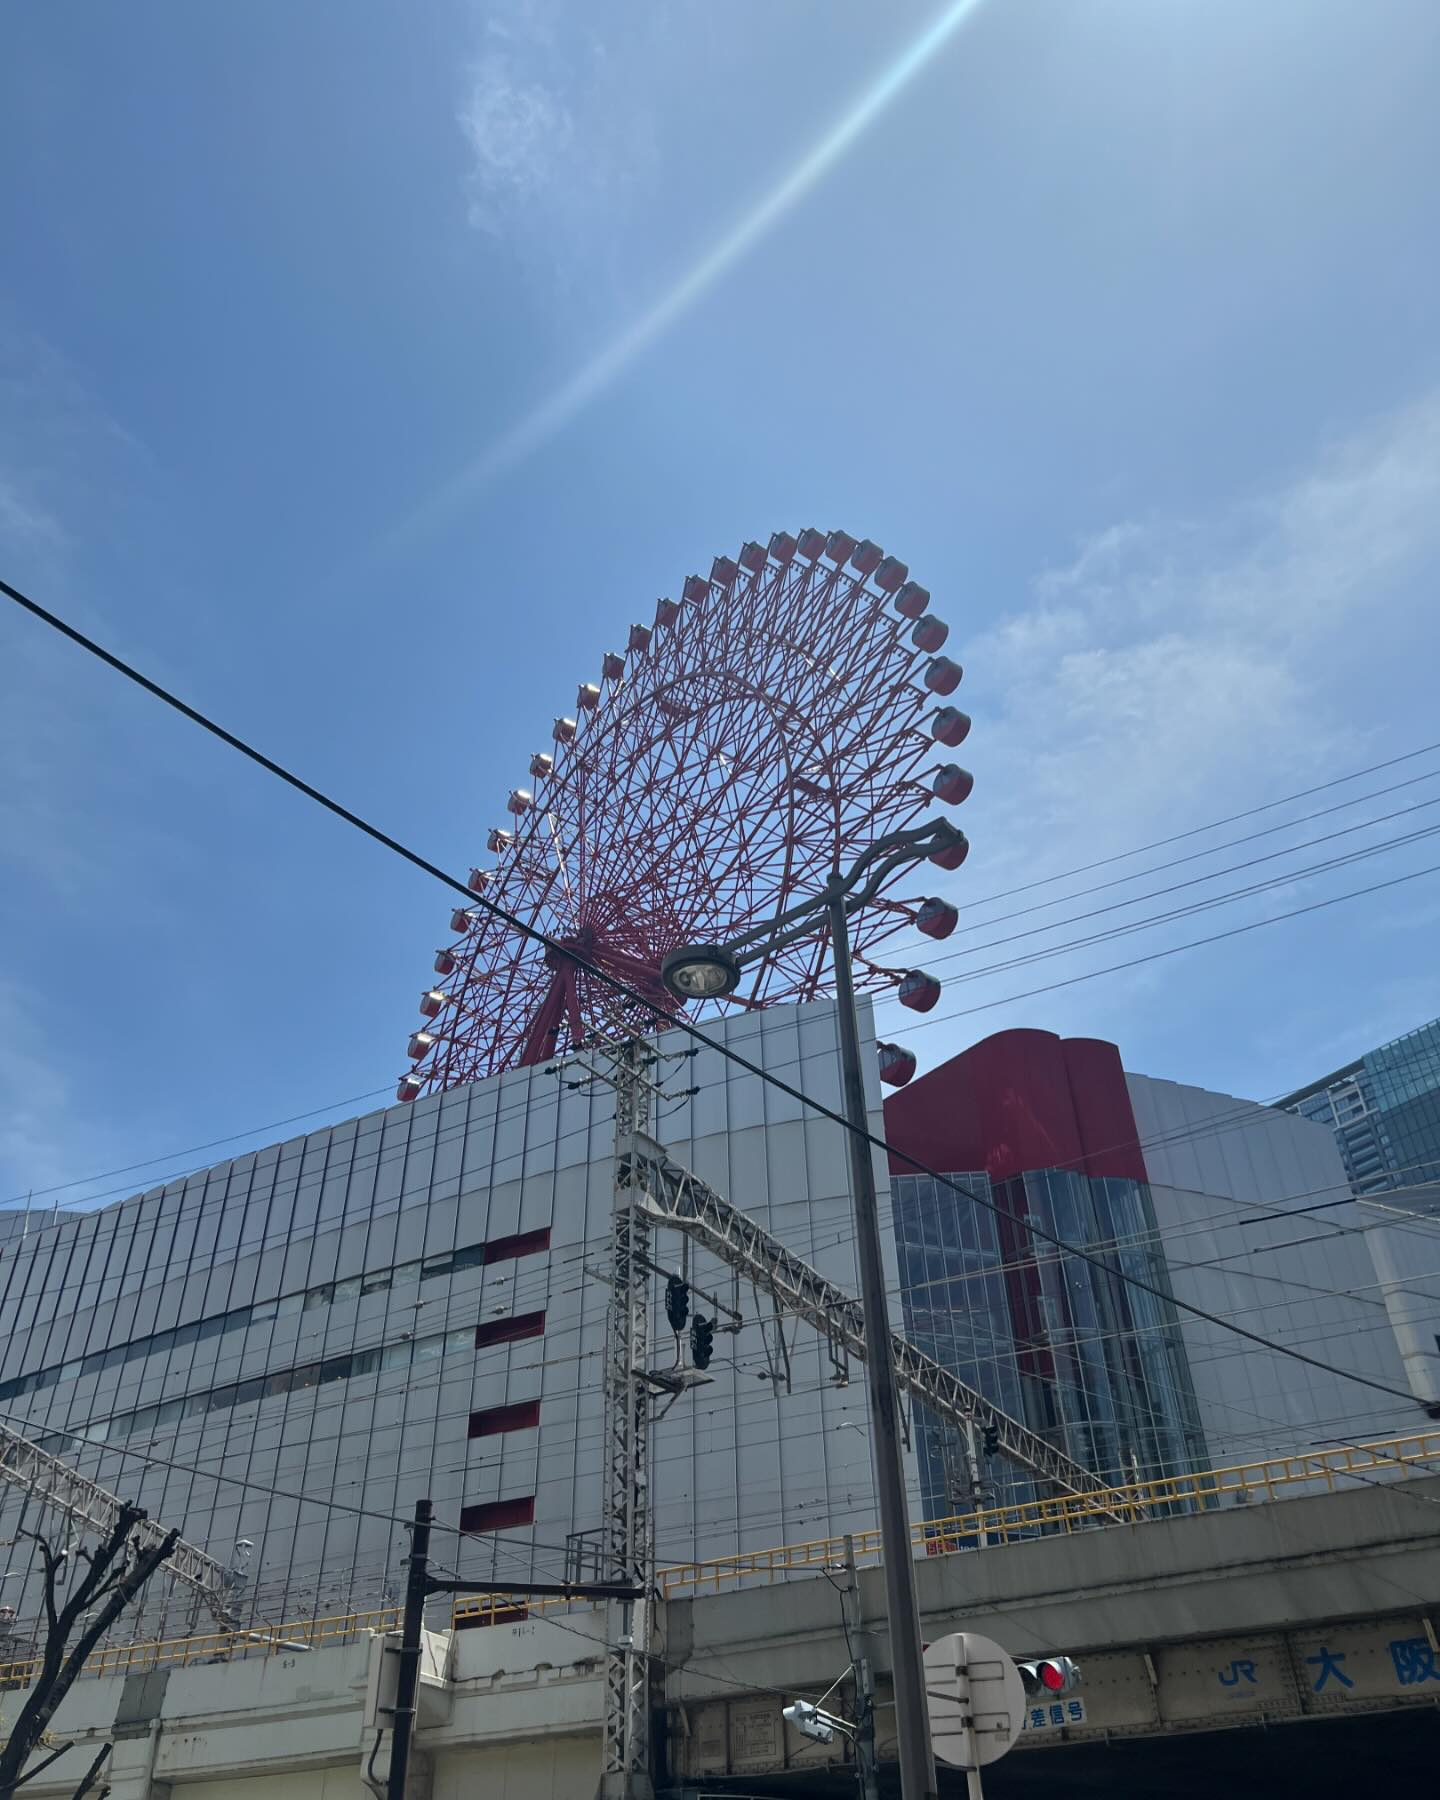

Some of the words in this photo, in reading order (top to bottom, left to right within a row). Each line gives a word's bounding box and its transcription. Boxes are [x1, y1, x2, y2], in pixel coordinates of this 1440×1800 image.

[1218, 1660, 1258, 1685] JR
[1023, 1701, 1083, 1729] 差信号
